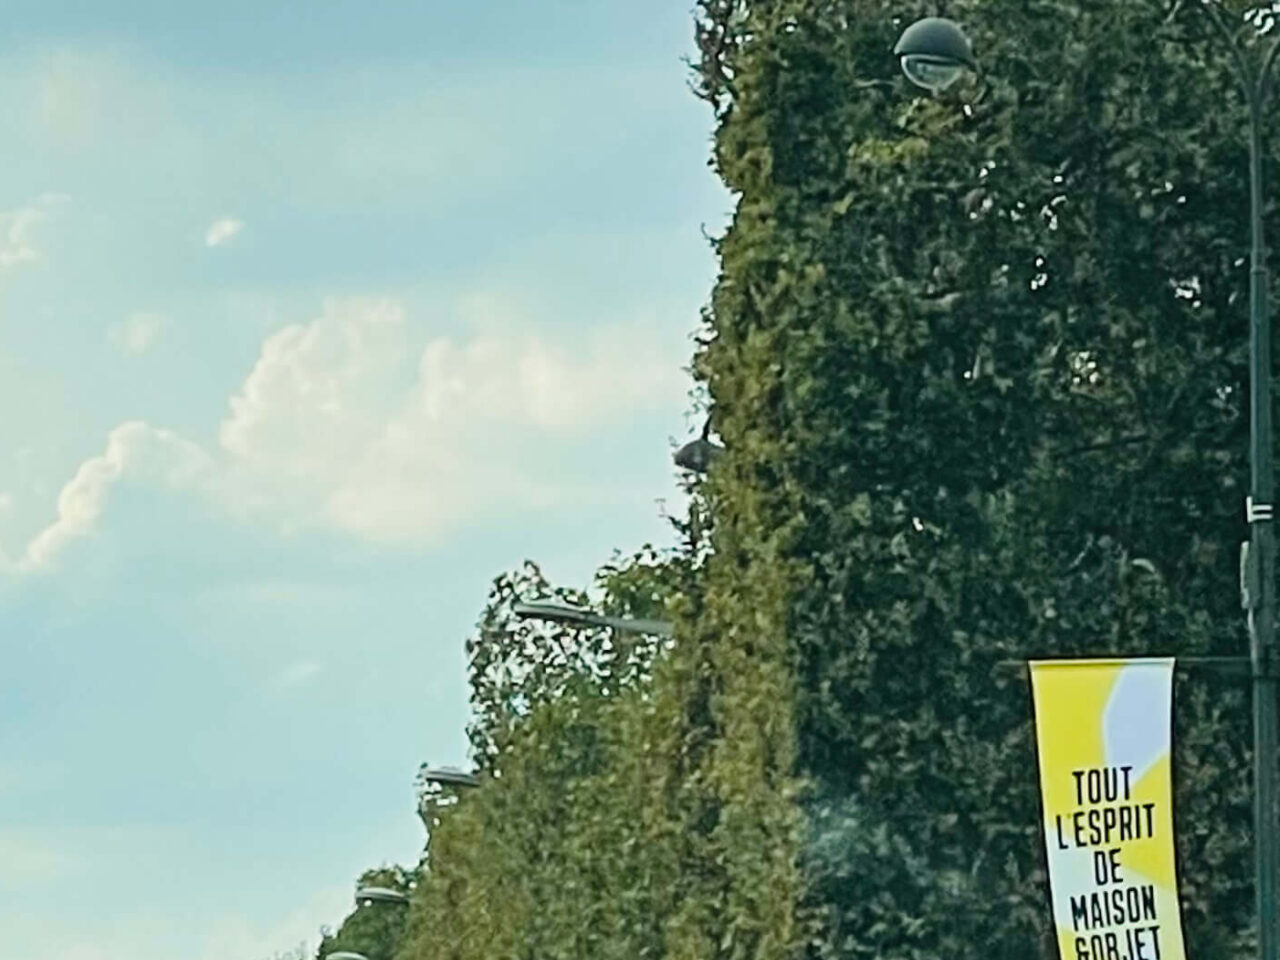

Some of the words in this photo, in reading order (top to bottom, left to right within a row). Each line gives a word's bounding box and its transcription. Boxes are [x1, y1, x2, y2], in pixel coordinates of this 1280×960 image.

[1072, 766, 1132, 806] TOUT
[1055, 803, 1155, 850] L'ESPRIT
[1094, 847, 1124, 886] DE
[1070, 884, 1156, 932] MAISON
